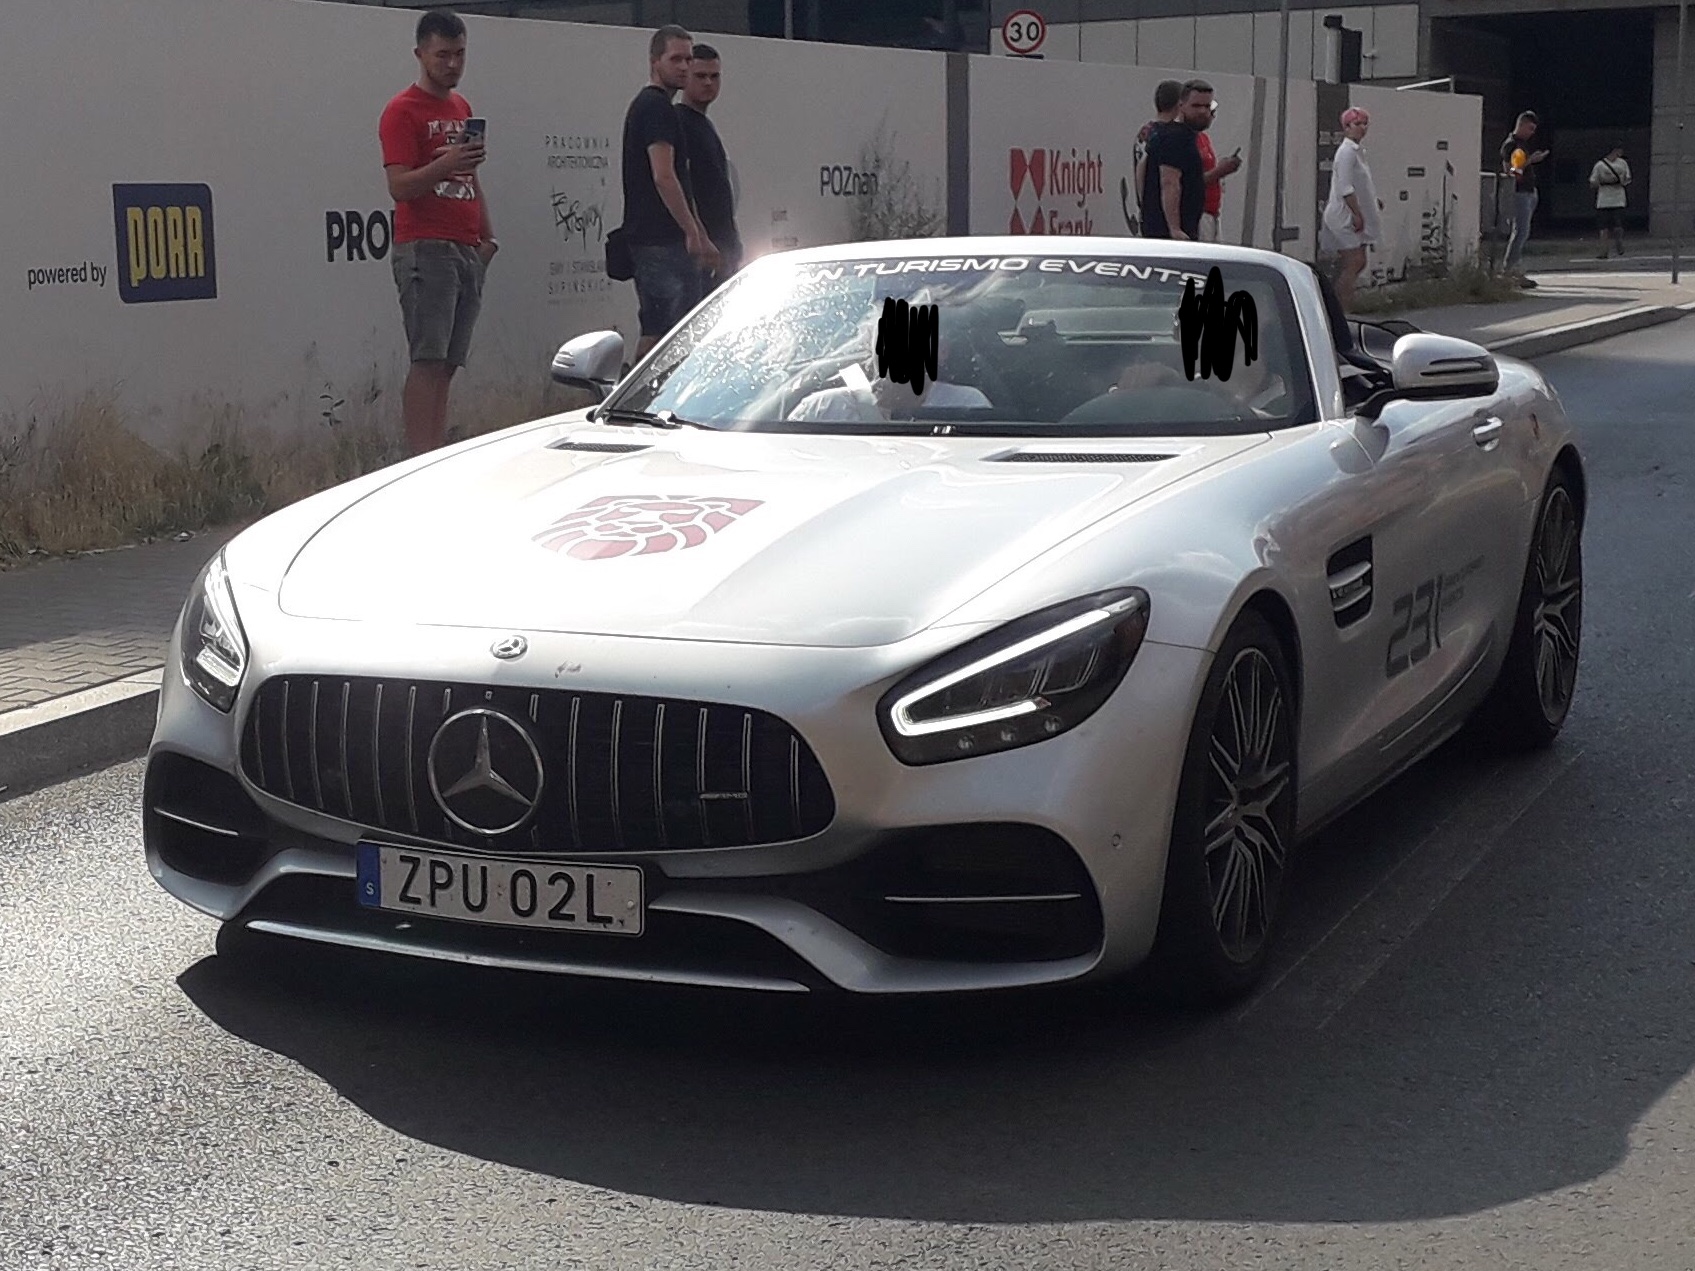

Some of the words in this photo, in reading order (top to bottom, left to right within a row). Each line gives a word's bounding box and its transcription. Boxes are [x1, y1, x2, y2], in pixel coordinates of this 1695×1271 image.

[1010, 21, 1040, 42] 30
[1049, 147, 1104, 208] Knight
[325, 210, 396, 262] PRO
[27, 261, 88, 290] powered
[90, 261, 107, 287] by
[853, 257, 1030, 278] TURISMO
[1038, 258, 1208, 289] EVENTS
[366, 881, 375, 896] S
[398, 854, 488, 913] ZPU
[510, 868, 614, 924] 02L
